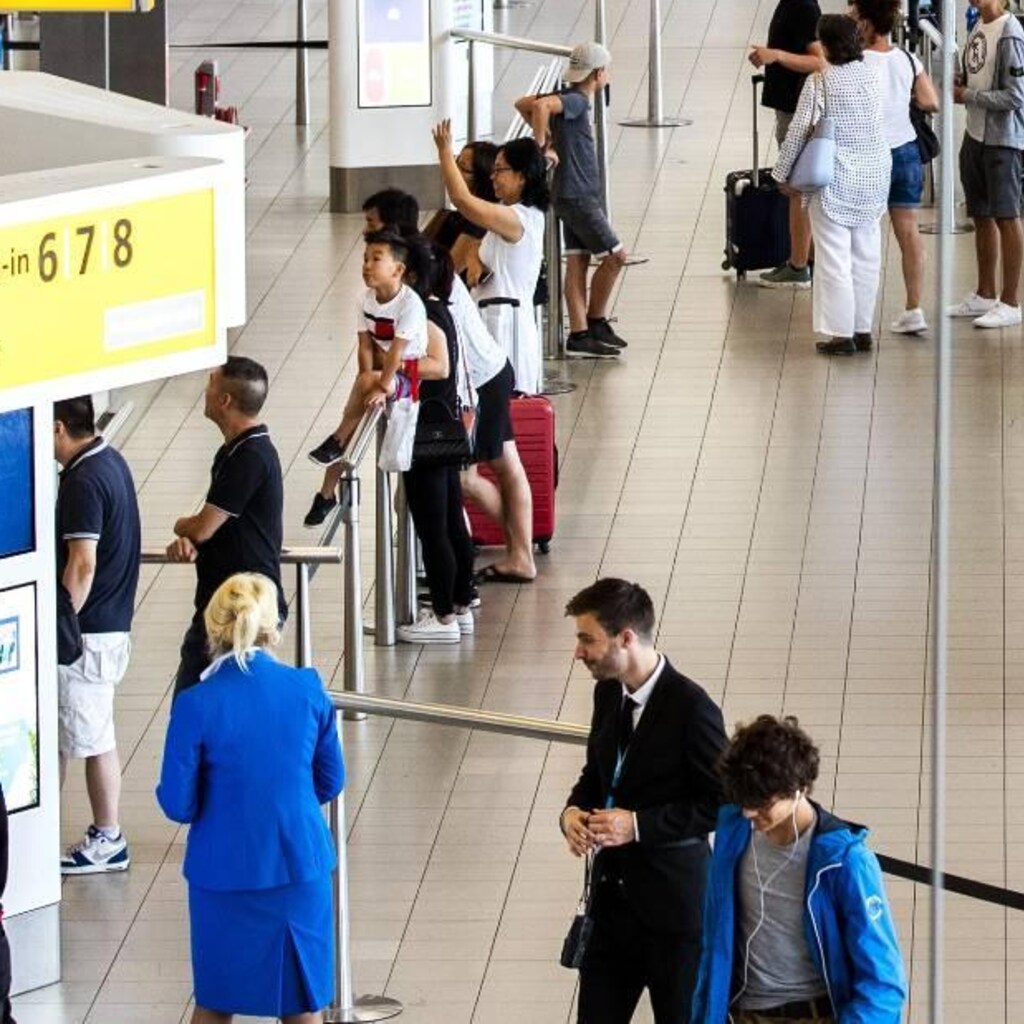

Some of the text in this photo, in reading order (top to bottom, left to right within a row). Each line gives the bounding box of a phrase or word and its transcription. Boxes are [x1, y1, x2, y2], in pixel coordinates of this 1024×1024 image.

[38, 231, 58, 283] 6
[75, 225, 95, 275] 7
[113, 218, 133, 268] 8
